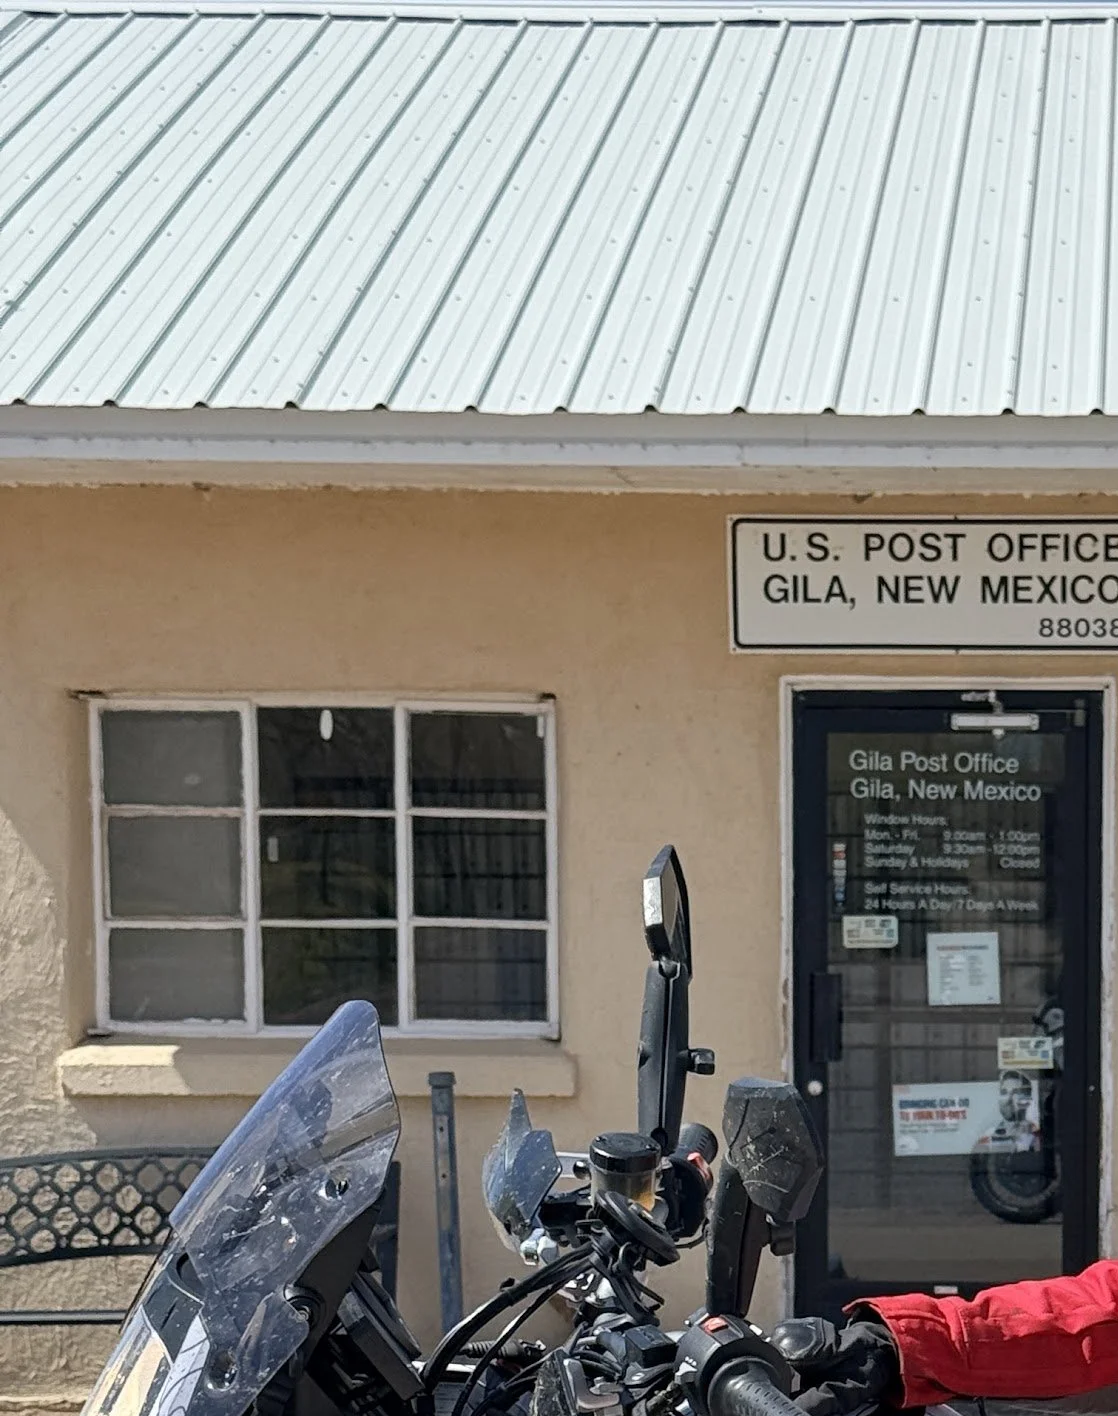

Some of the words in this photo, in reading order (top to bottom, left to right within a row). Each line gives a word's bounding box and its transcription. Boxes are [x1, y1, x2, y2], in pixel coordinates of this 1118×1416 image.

[763, 532, 840, 562] U.S.
[864, 532, 967, 562] POST
[763, 574, 856, 610] GILA,
[877, 575, 961, 604] NEW
[849, 750, 893, 771] Gila
[900, 751, 949, 772] Post
[954, 752, 1019, 774] Office
[850, 777, 900, 802] Gila,
[908, 779, 958, 800] New
[963, 780, 1041, 802] Mexico
[864, 814, 909, 825] Window
[864, 842, 915, 855] Saturday
[864, 856, 907, 870] Sunday
[909, 857, 918, 868] &
[921, 856, 969, 870] Holidays
[1000, 858, 1039, 869] Closed
[864, 881, 887, 894] Self
[889, 881, 932, 894] Service
[864, 899, 879, 910] 24
[881, 899, 916, 910] Hours
[918, 900, 927, 910] A
